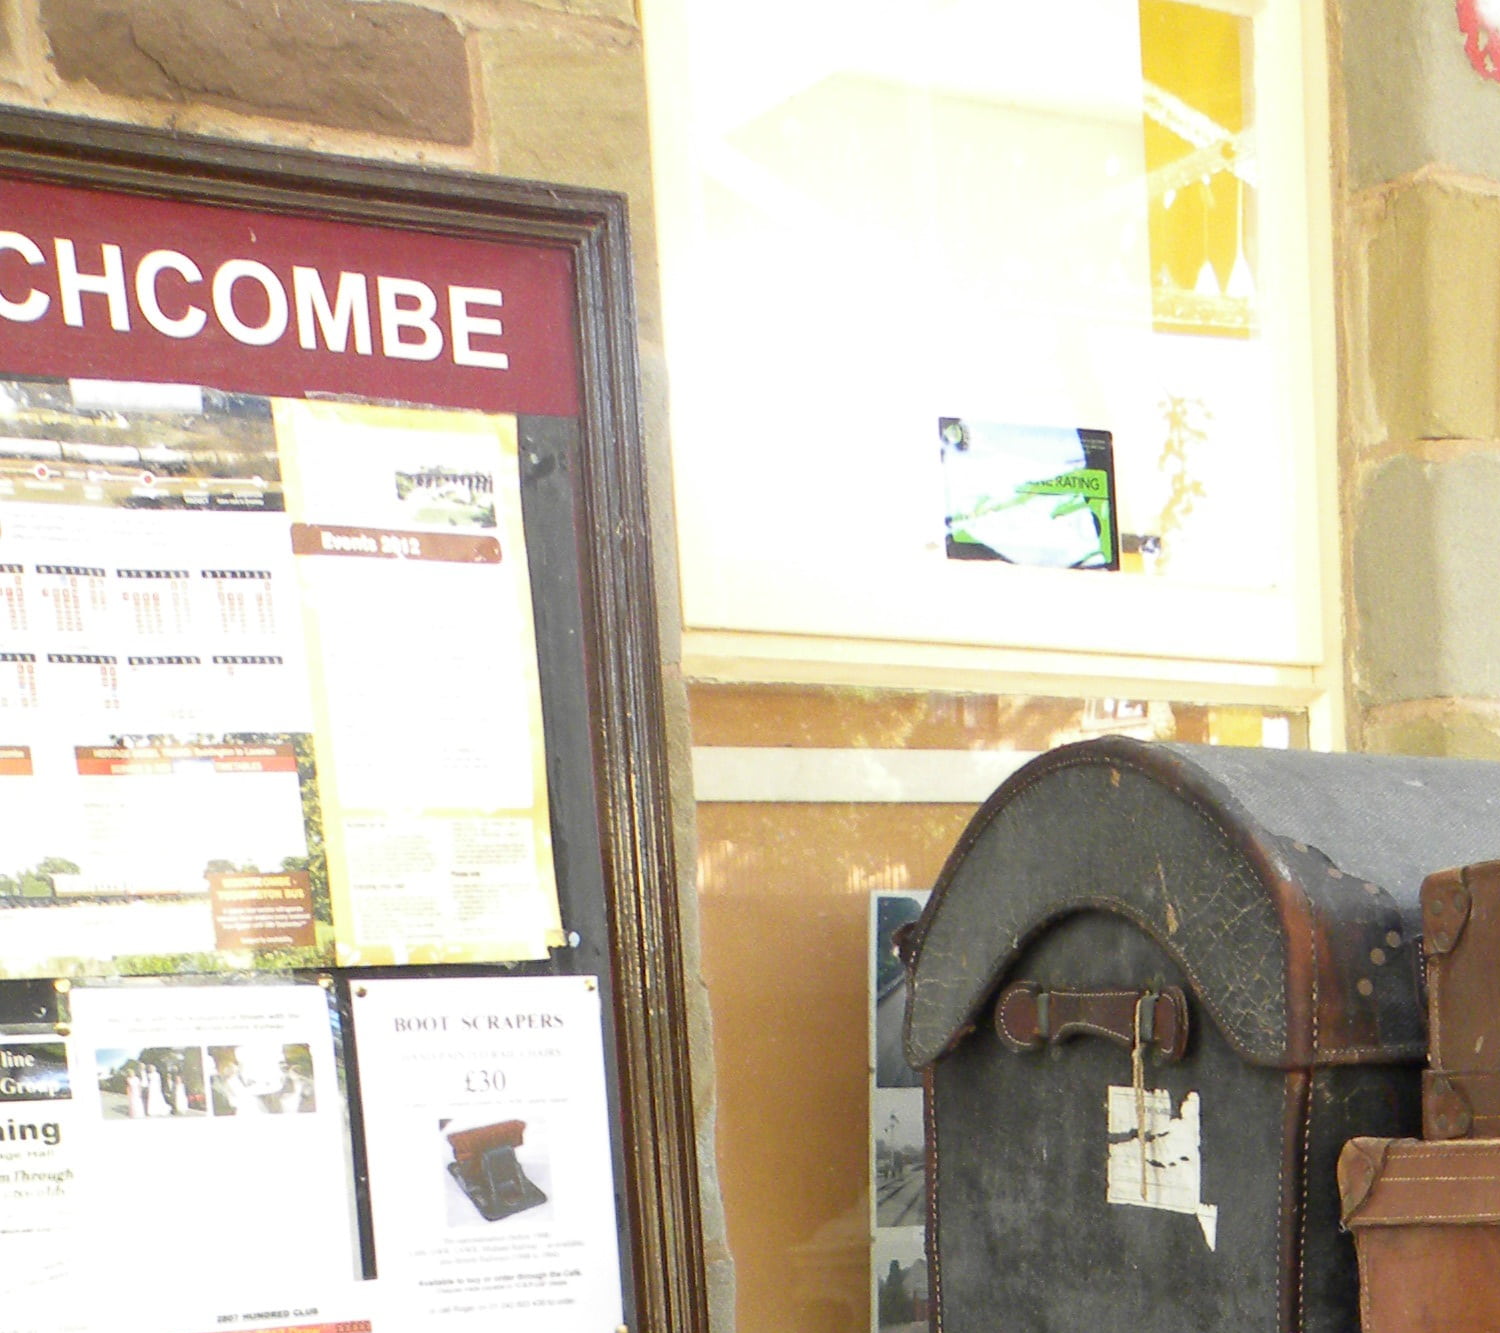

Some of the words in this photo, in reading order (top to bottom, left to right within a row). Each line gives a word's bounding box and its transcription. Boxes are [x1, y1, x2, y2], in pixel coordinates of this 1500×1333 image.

[1055, 475, 1100, 491] RATING
[319, 531, 378, 553] Events
[394, 1016, 449, 1033] BOOT
[461, 1014, 565, 1030] SCRAPERS
[464, 1069, 507, 1093] £30
[243, 1309, 290, 1321] HUNDRED
[293, 1306, 319, 1317] CLUB
